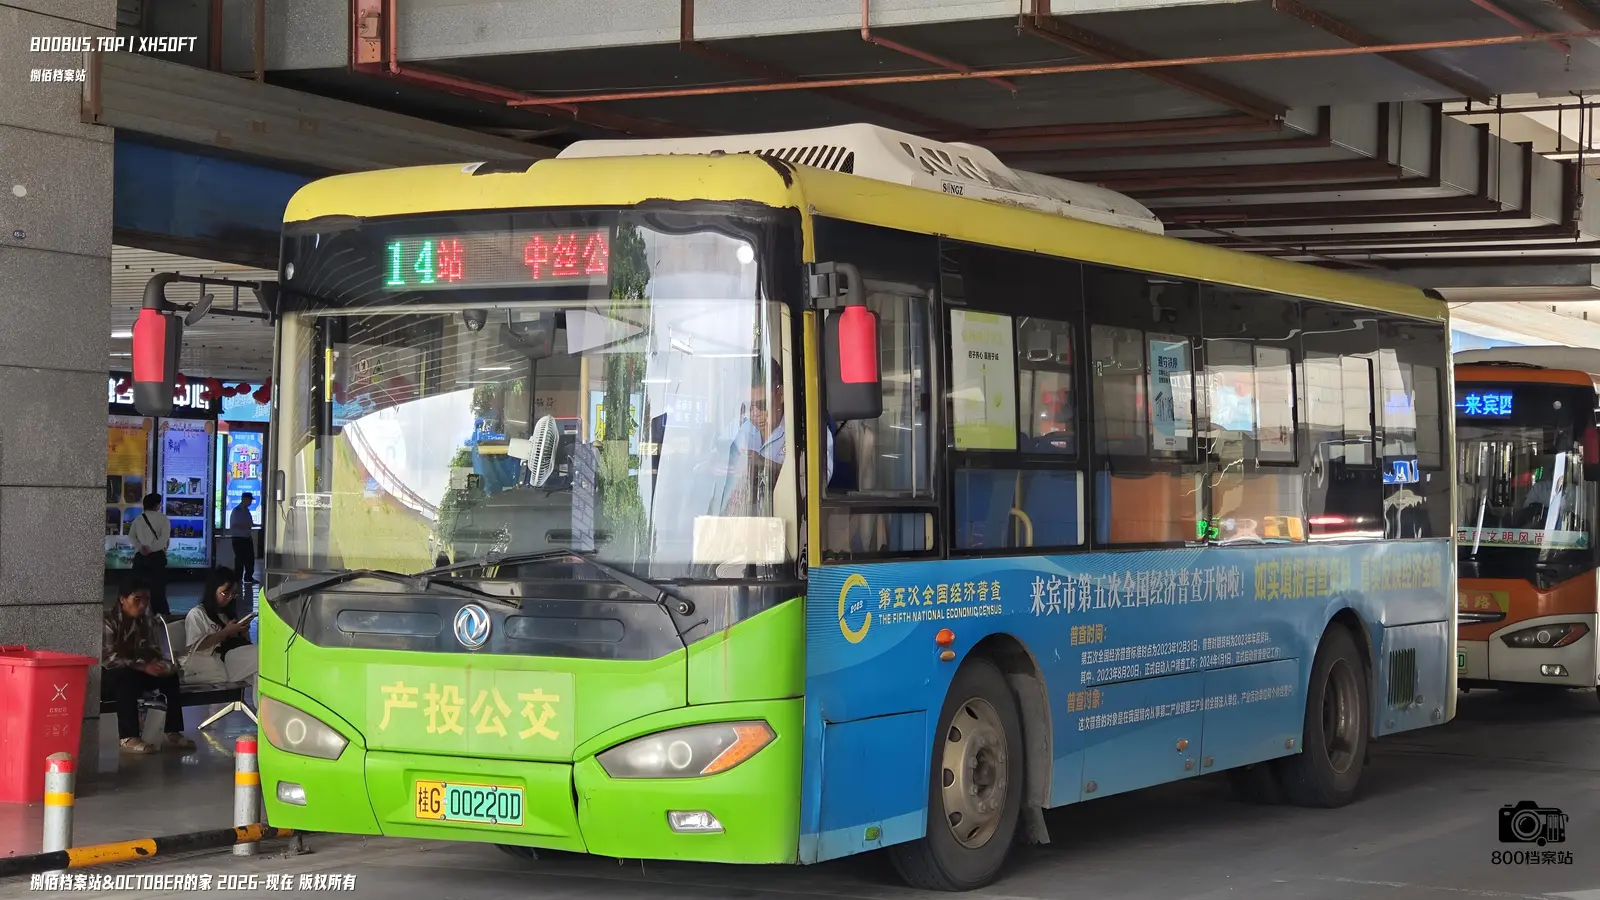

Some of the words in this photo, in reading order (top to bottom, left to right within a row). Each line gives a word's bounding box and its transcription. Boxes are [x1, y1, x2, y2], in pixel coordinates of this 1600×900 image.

[387, 240, 435, 285] 14
[524, 233, 609, 280] 中丝公
[878, 580, 1002, 610] 第五次全国经济普查
[879, 614, 892, 625] THE
[892, 611, 912, 623] FIFTH
[912, 608, 945, 621] NATIONAL
[379, 681, 560, 741] 产投公交
[418, 787, 441, 814] 桂G
[450, 789, 521, 820] 00220D
